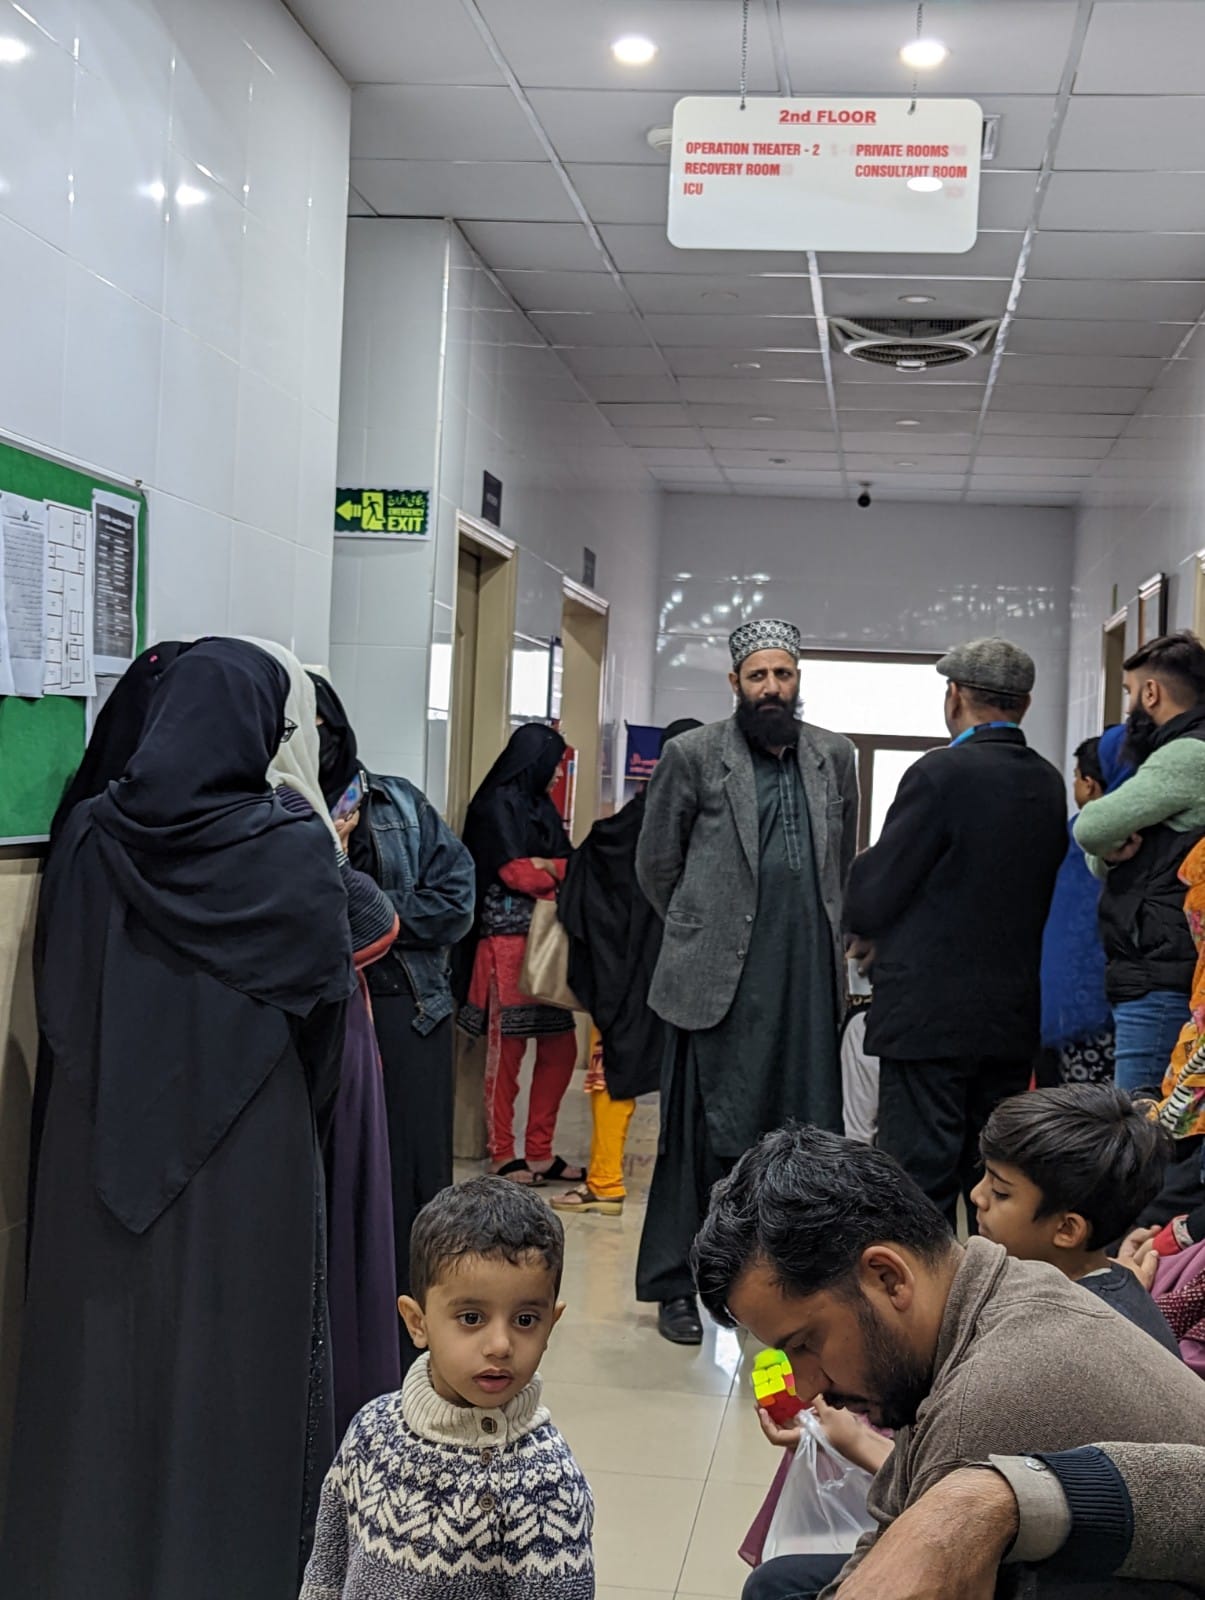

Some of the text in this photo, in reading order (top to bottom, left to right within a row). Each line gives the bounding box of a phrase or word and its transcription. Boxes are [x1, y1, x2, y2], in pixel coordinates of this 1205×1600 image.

[779, 109, 877, 124] 2nd FLOOR
[686, 142, 749, 155] OPERATION
[752, 143, 801, 156] THEATER
[812, 144, 820, 156] 2
[856, 144, 903, 157] PRIVATE
[906, 145, 949, 157] ROOMS
[685, 162, 743, 175] RECOVERY
[746, 163, 780, 176] ROOM
[855, 165, 967, 178] CONSULTANT ROOM
[683, 182, 704, 195] ICU
[388, 516, 424, 532] EXIT
